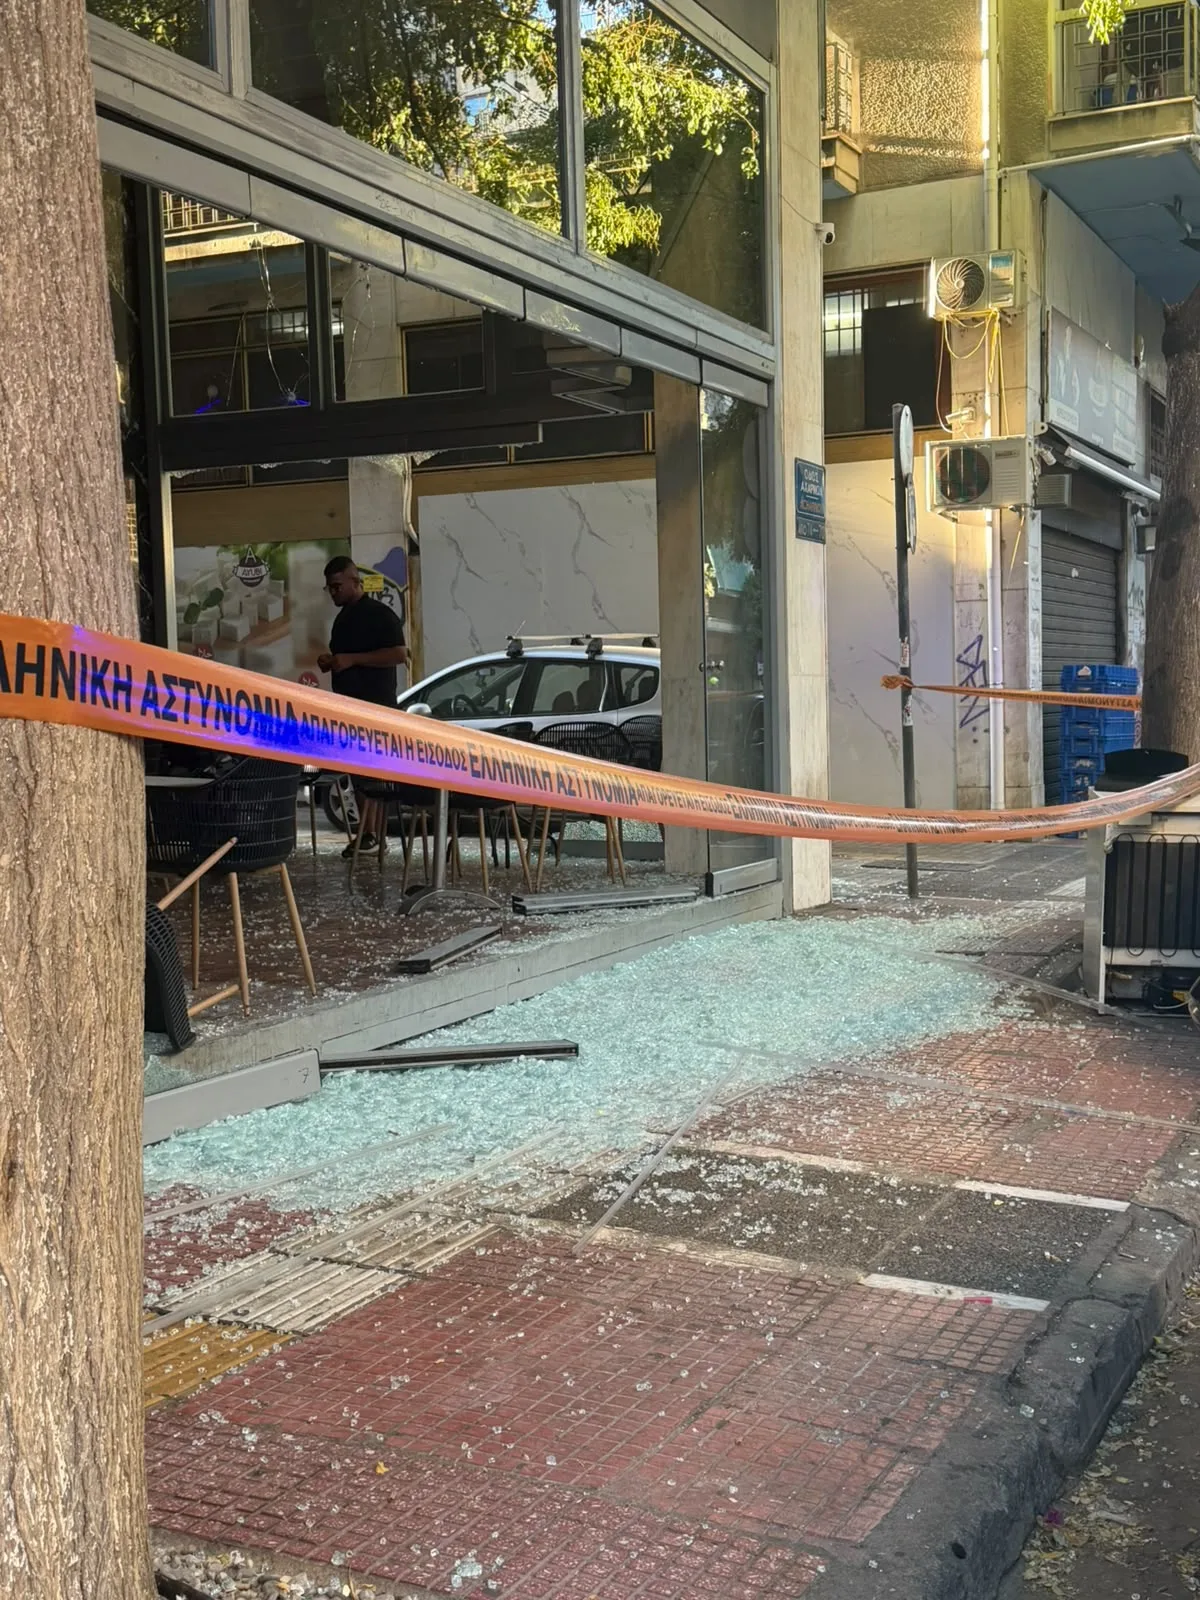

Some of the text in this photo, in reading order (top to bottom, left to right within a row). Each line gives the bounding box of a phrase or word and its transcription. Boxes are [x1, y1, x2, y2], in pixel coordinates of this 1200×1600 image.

[140, 669, 300, 746] ΑΣΤΥΝΟΜΙΑ
[299, 711, 403, 757] ΑΠΑΓΟΡΕΥΕΤΑΙ
[406, 737, 414, 761] Η
[417, 739, 467, 771] ΕΙΣΟΔΟΣ
[467, 742, 553, 792] ΕΛΛΗΝΙΚΗ
[555, 764, 639, 806] ΑΣΤΥΝΟΜΙΑ
